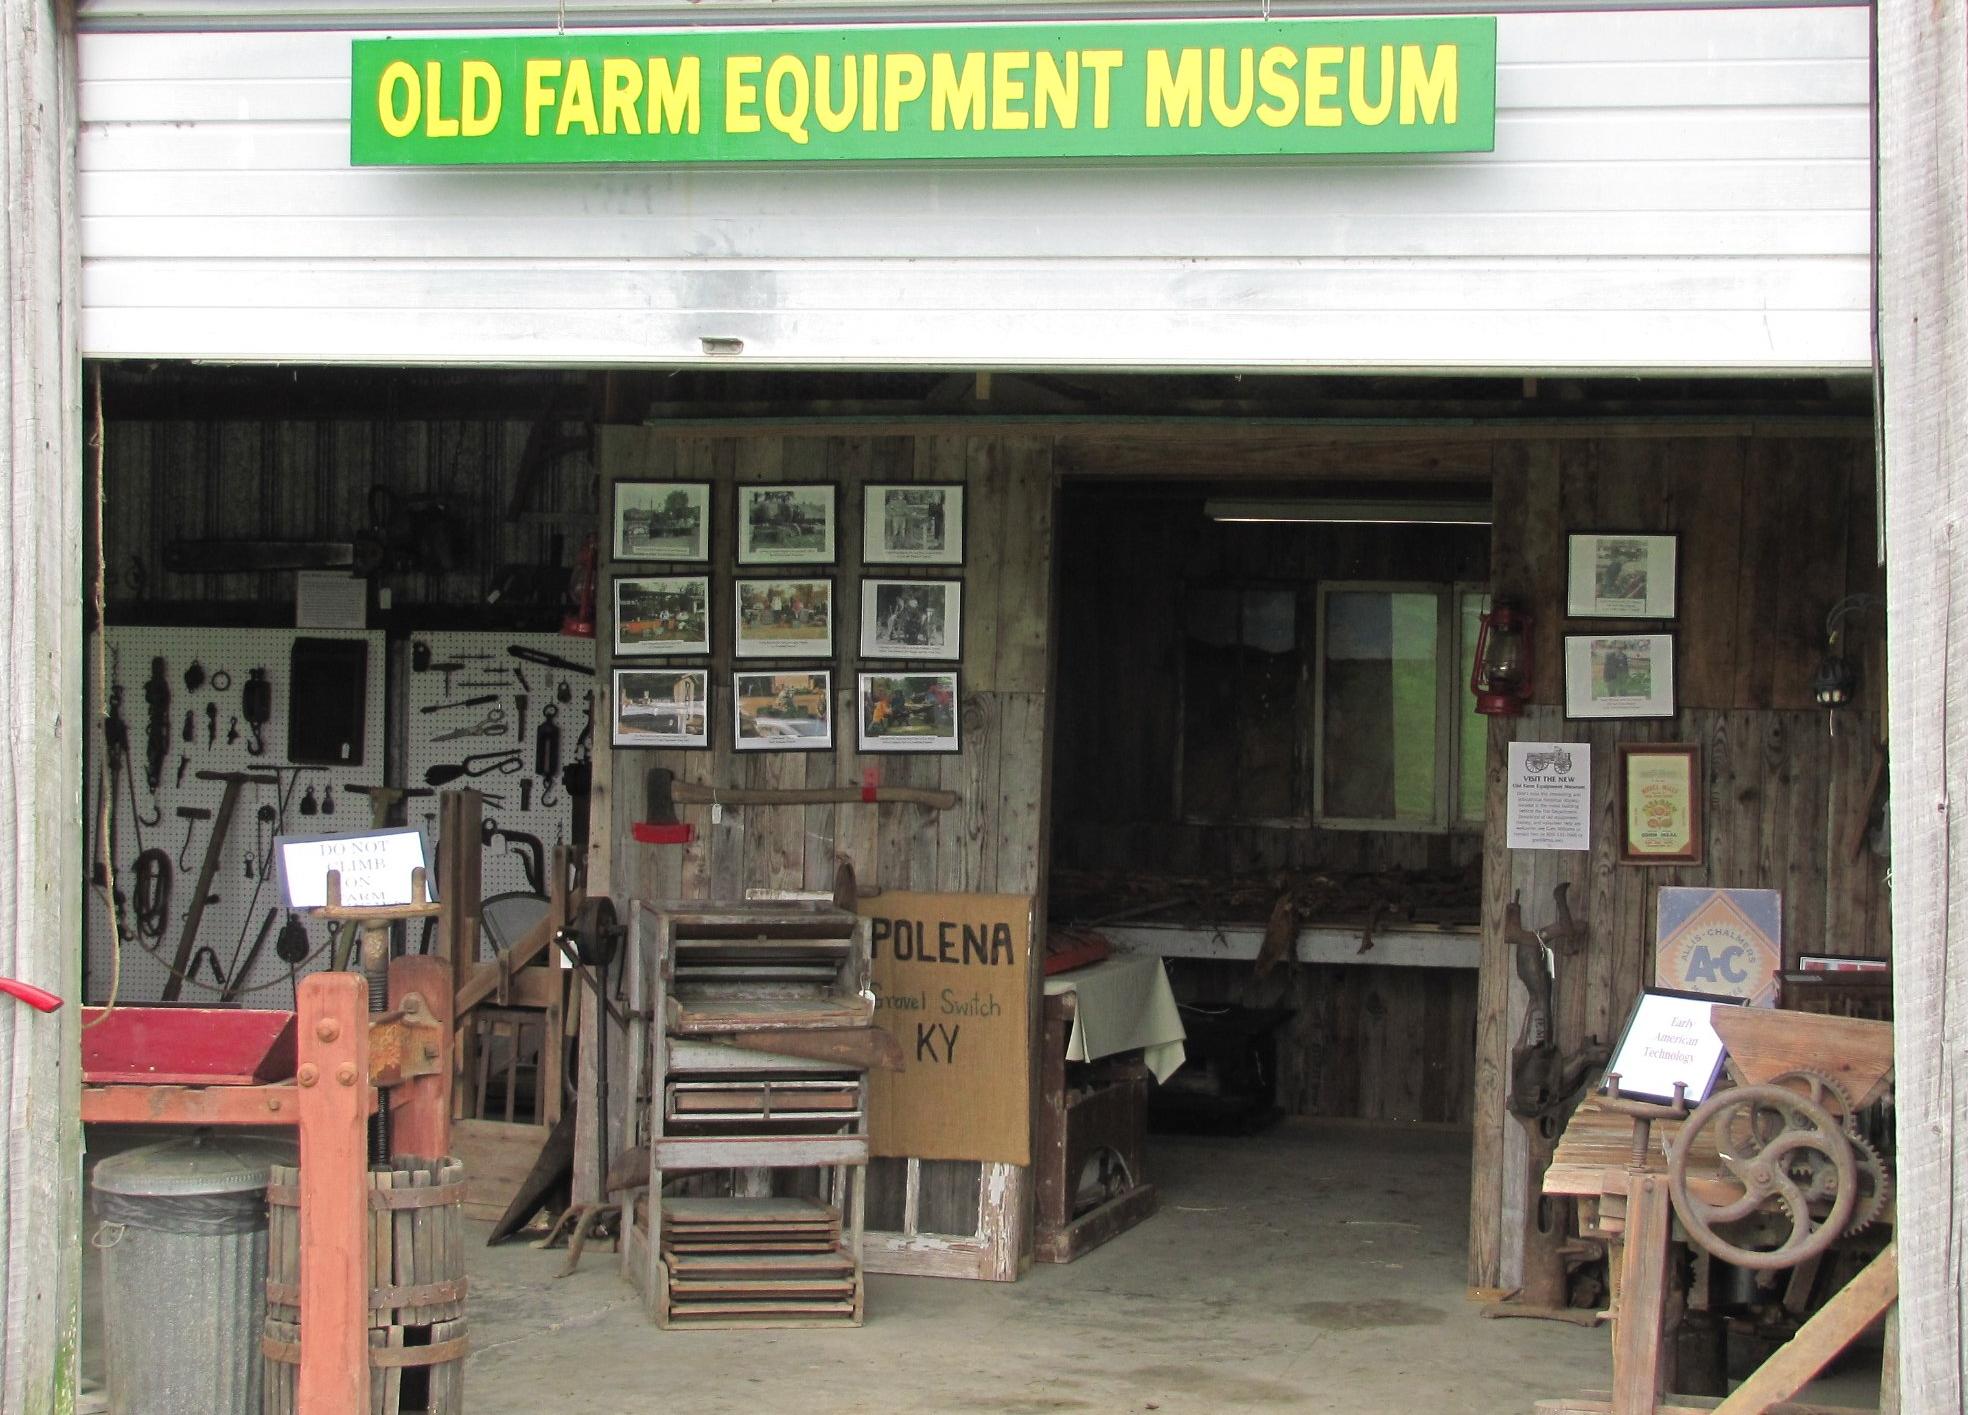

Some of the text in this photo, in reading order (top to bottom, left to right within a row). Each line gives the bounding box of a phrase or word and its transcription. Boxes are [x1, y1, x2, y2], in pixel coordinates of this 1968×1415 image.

[377, 44, 1459, 145] OLD FARM EQUIPMENT MUSEUM
[1523, 775, 1576, 784] VISIT THE NEW
[320, 840, 388, 857] DO NOT
[345, 875, 371, 888] ON
[871, 917, 1014, 966] POLENA
[941, 988, 1002, 1017] Switch
[1671, 1016, 1696, 1031] Early
[916, 1022, 960, 1064] KY
[1656, 1032, 1699, 1047] American
[1643, 1046, 1695, 1064] Technology
